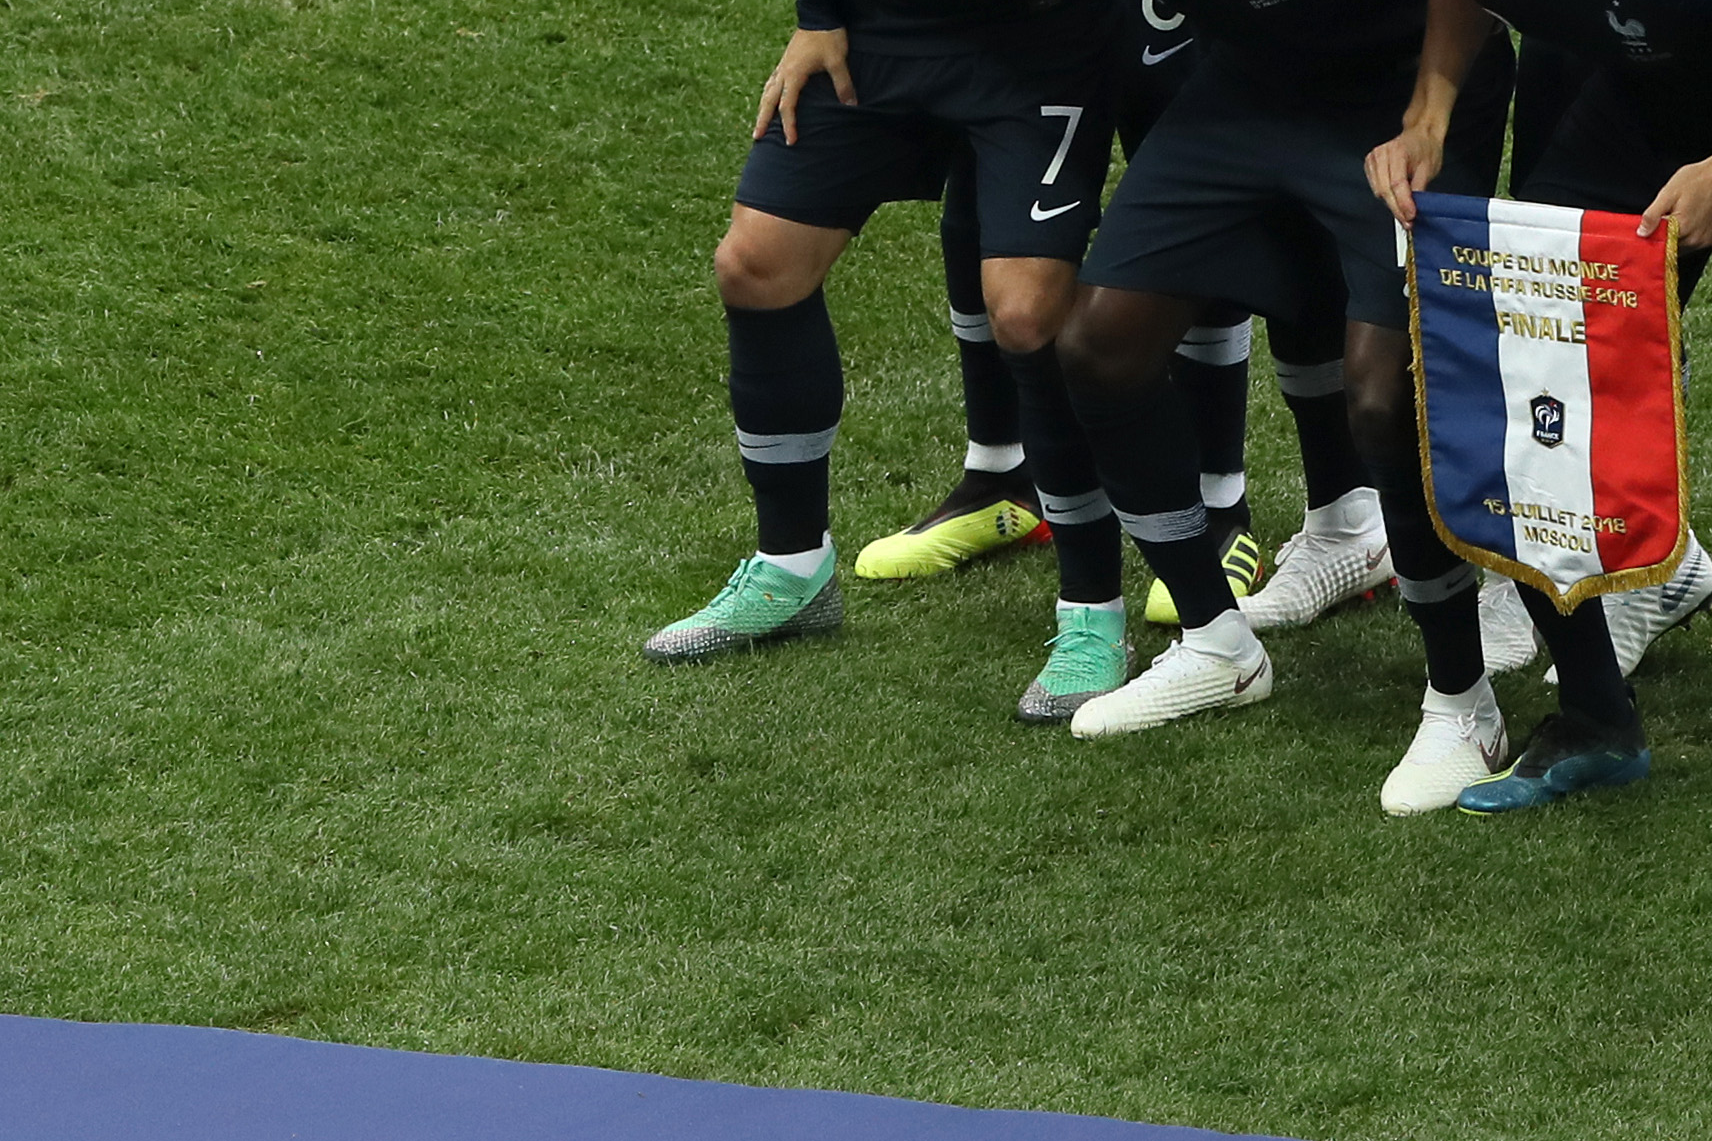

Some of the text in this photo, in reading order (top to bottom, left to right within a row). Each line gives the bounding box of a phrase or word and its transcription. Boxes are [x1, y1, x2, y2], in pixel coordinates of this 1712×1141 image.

[1040, 105, 1084, 185] 7
[1452, 245, 1620, 281] COUPE DU MONDE
[1439, 268, 1639, 308] DE LA FIFA RUSSIE 2018
[1497, 310, 1588, 345] FINALE
[1483, 498, 1627, 534] 15 JUILLET 2018
[1523, 524, 1593, 554] MOSCOU
